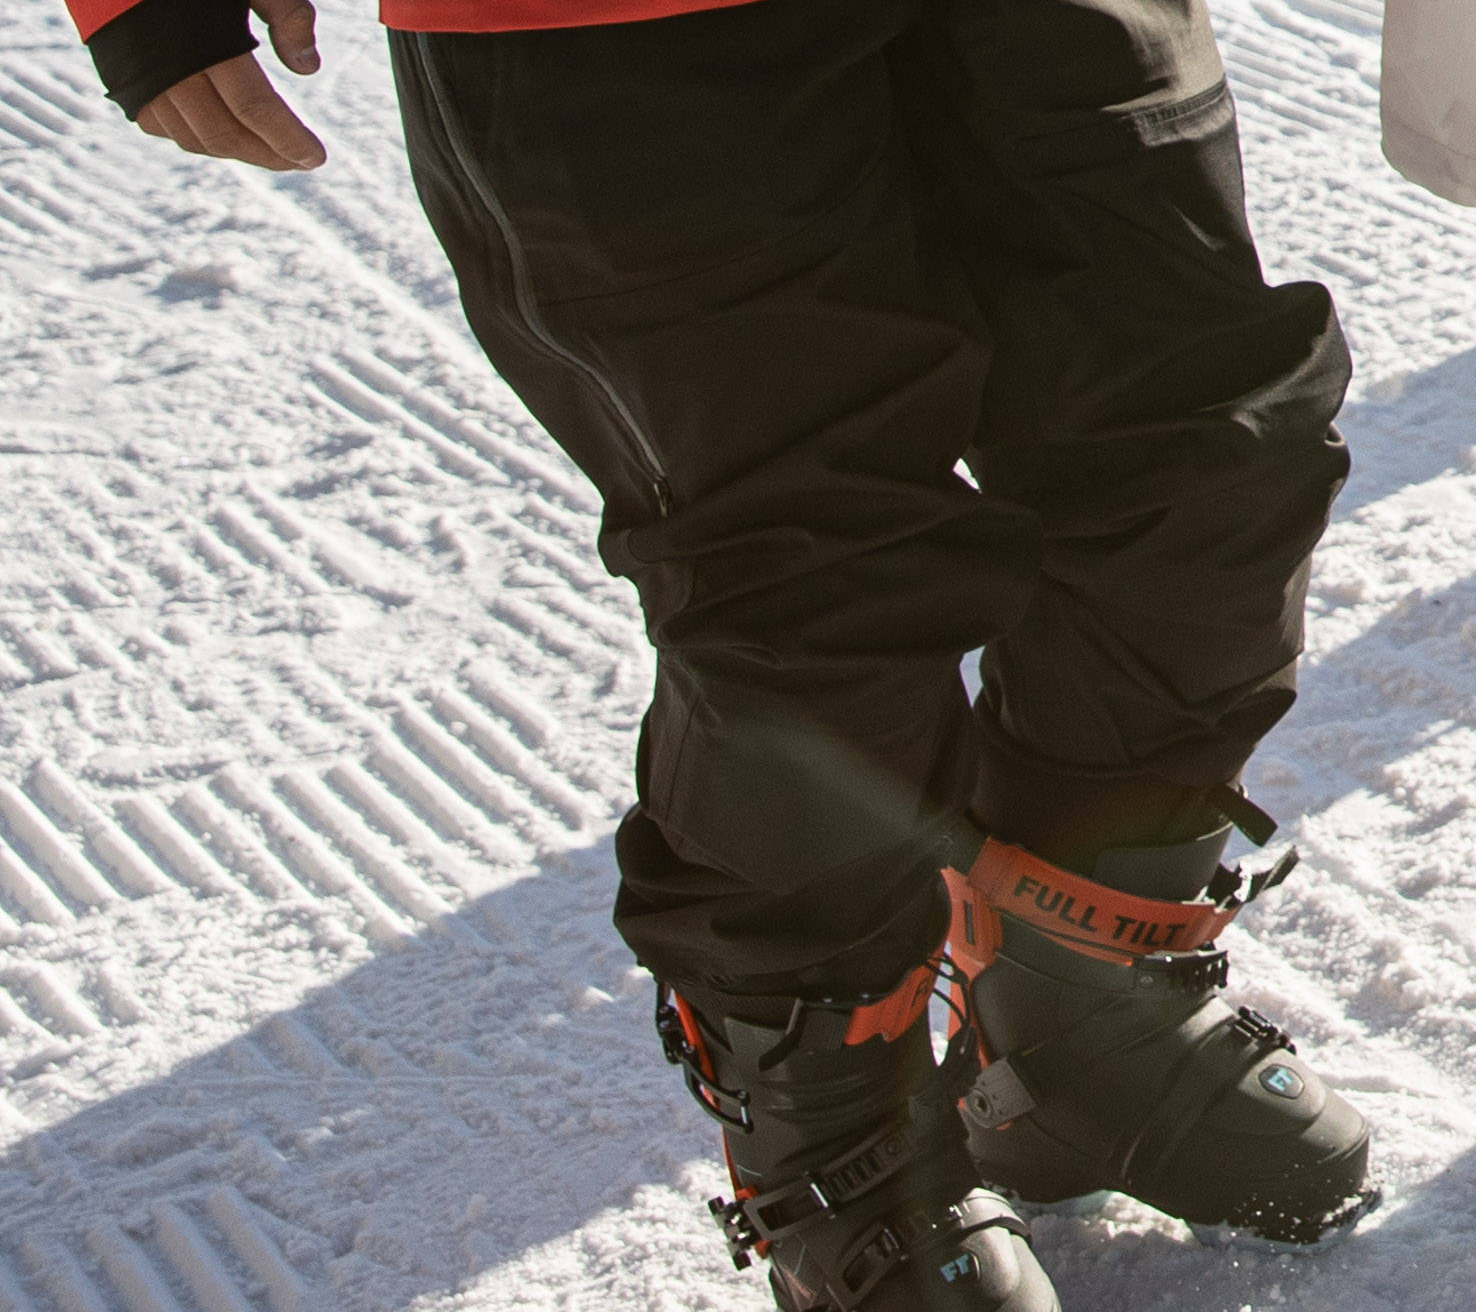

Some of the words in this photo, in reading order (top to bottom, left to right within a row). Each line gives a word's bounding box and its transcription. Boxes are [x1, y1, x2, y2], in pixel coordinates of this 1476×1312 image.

[1013, 875, 1099, 934] FULL
[1111, 914, 1186, 948] TILT
[939, 1253, 970, 1284] FT
